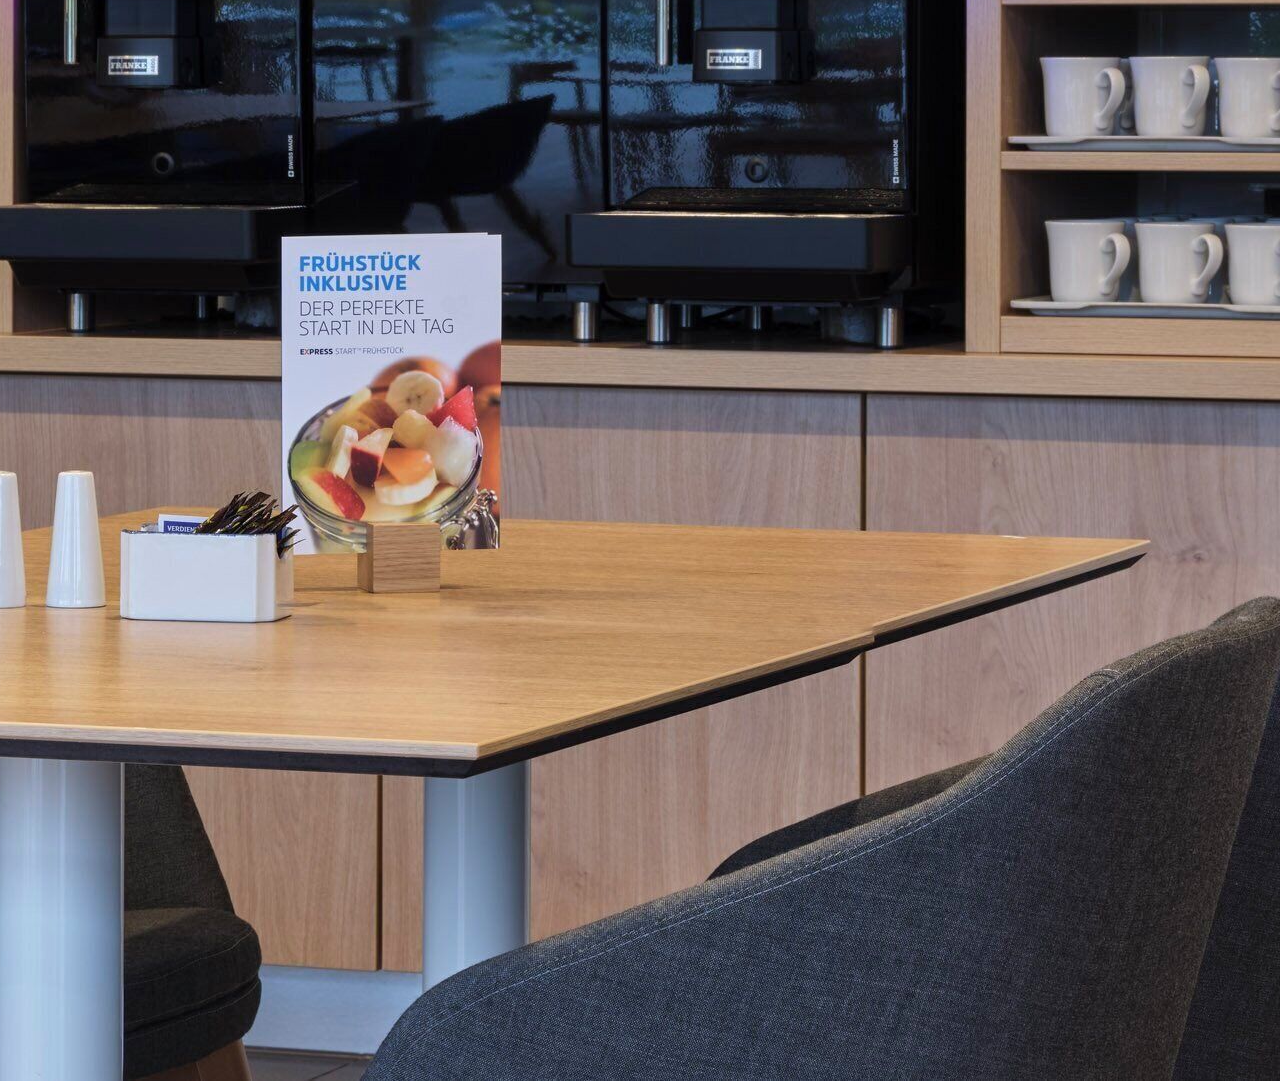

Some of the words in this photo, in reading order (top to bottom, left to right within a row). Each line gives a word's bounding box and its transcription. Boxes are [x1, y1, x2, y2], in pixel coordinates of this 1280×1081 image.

[709, 55, 750, 64] FRANKE
[299, 251, 422, 272] FRÜHSTÜCK
[299, 274, 407, 292] INKLUSIVE
[299, 300, 334, 317] DER
[340, 299, 425, 316] PERFEKTE
[299, 319, 351, 337] START
[357, 319, 374, 335] IN
[380, 319, 415, 335] DEN
[421, 318, 454, 334] TAG
[299, 347, 334, 356] EXPRESS
[362, 345, 404, 355] FRÜHSTÜCK
